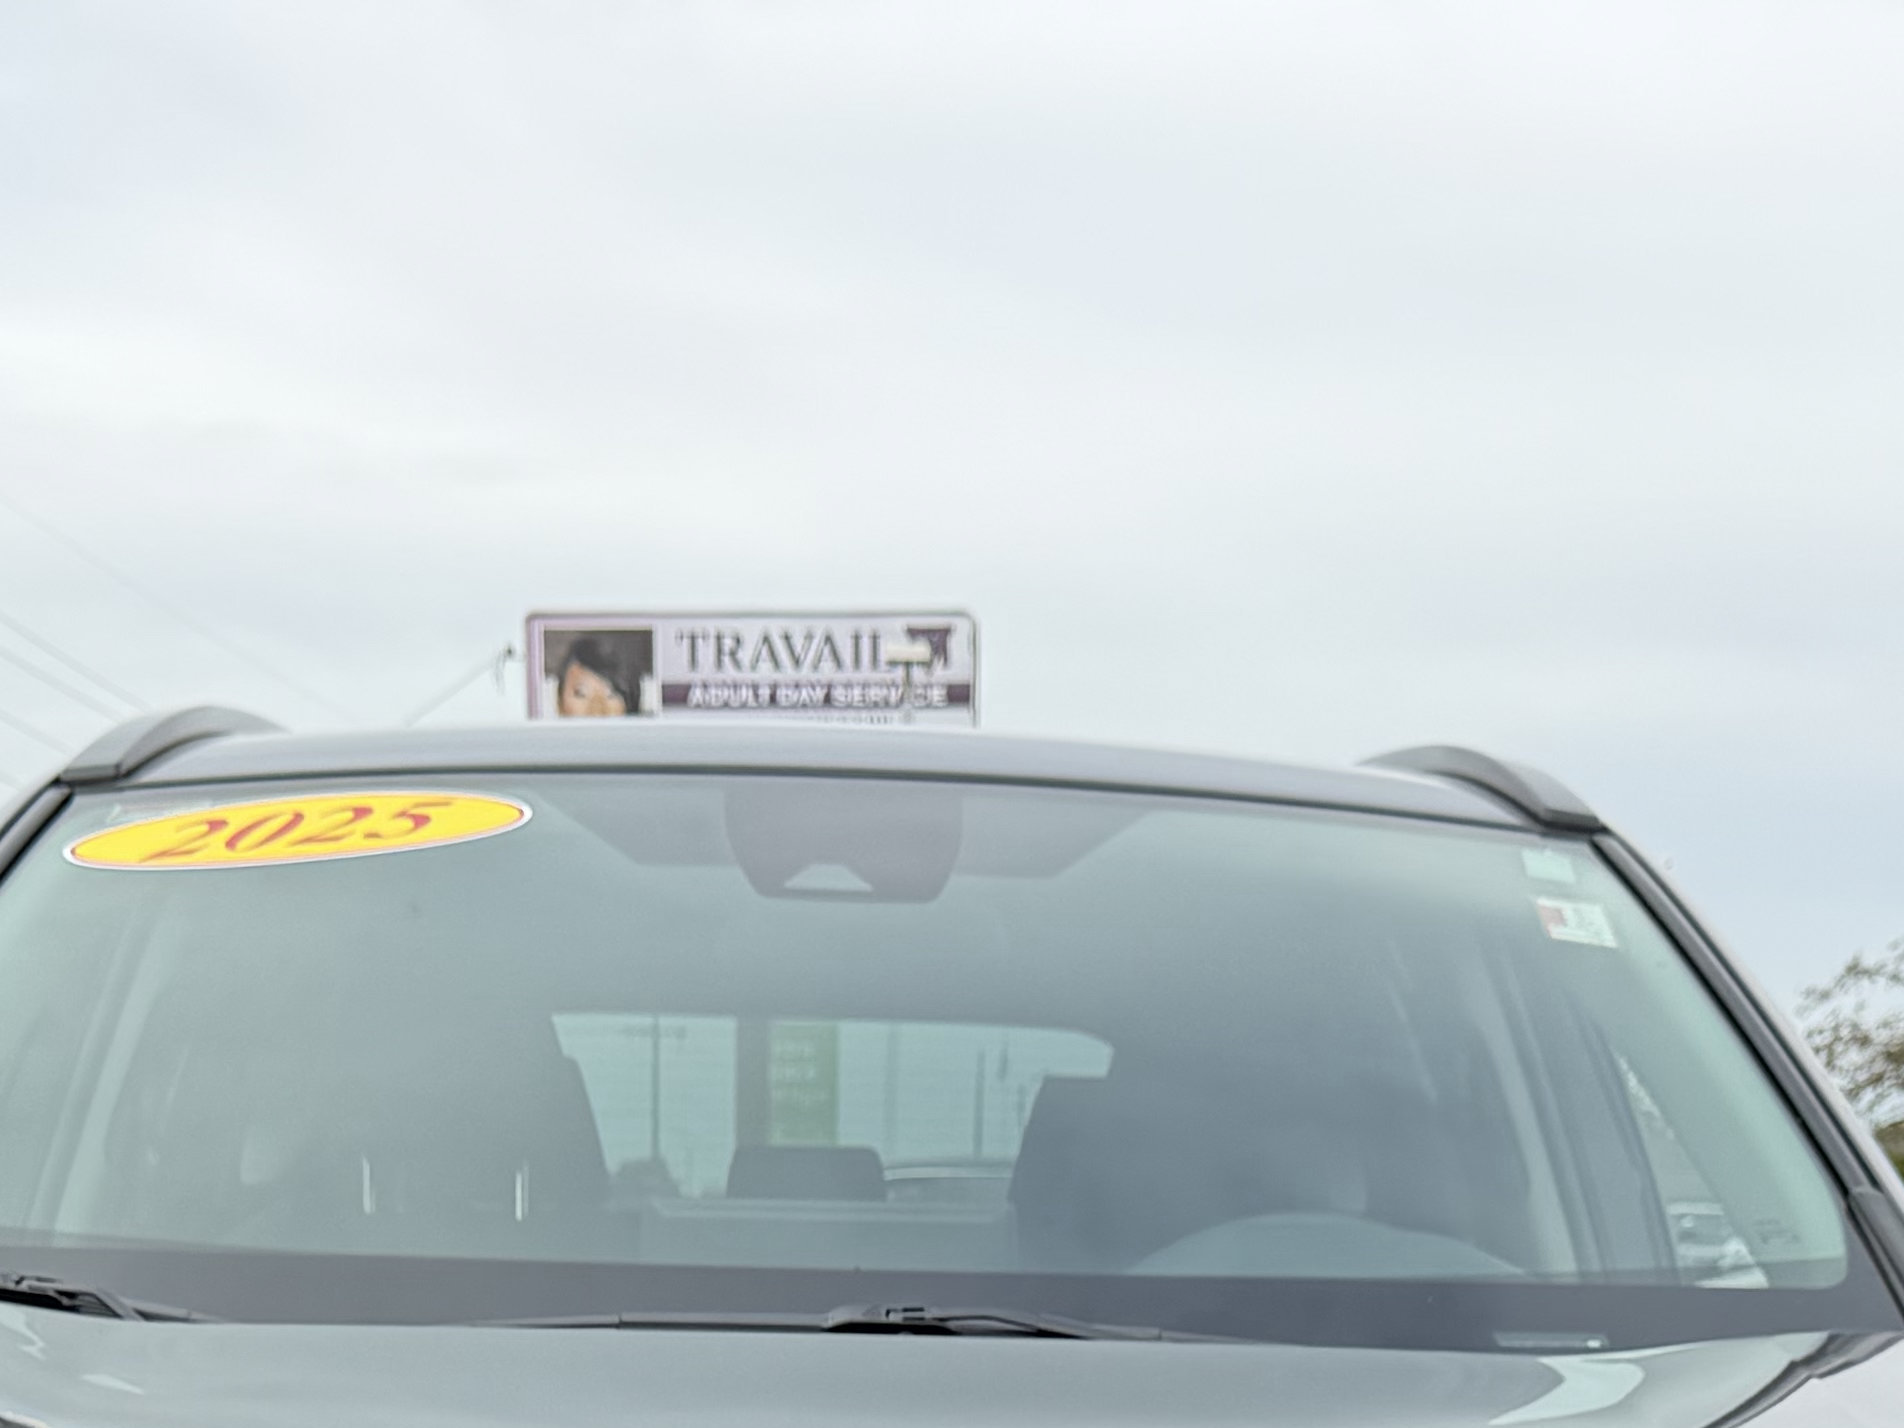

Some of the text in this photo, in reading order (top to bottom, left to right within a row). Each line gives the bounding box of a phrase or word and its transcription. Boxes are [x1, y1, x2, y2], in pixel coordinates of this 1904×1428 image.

[675, 628, 892, 671] TRAVAIL
[688, 683, 948, 707] ADULT DAY SERVCE
[138, 801, 453, 863] 2025
